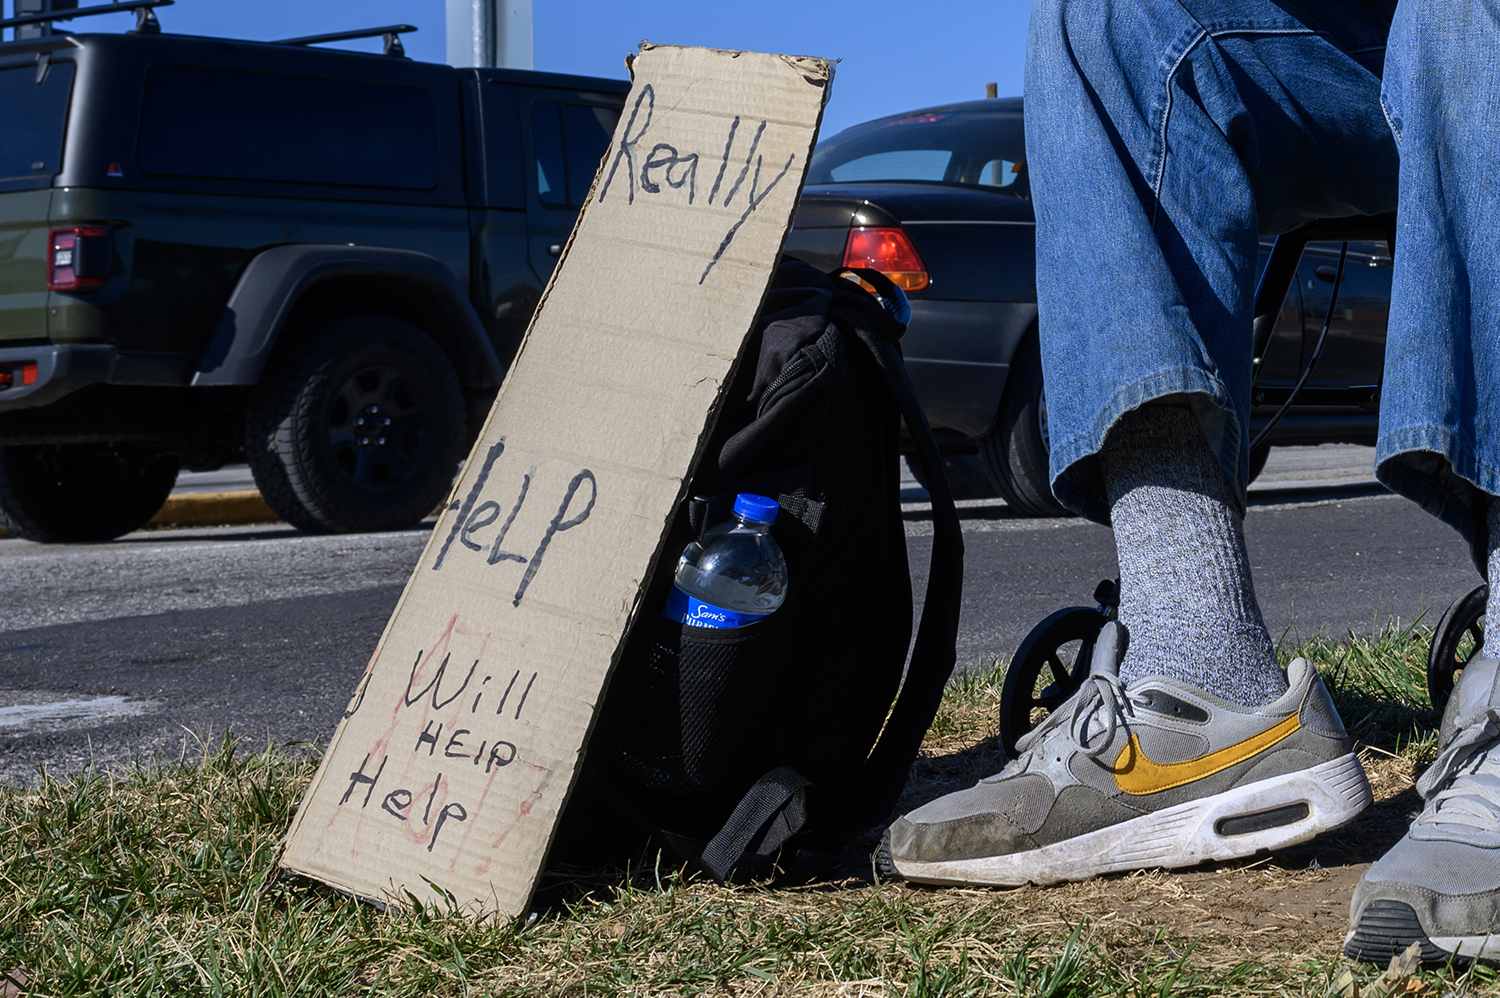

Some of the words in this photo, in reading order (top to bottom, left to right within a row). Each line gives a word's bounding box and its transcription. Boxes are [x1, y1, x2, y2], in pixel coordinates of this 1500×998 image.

[599, 83, 795, 285] Really
[690, 604, 726, 622] Sam's
[405, 649, 537, 719] Will
[339, 753, 468, 852] Help
